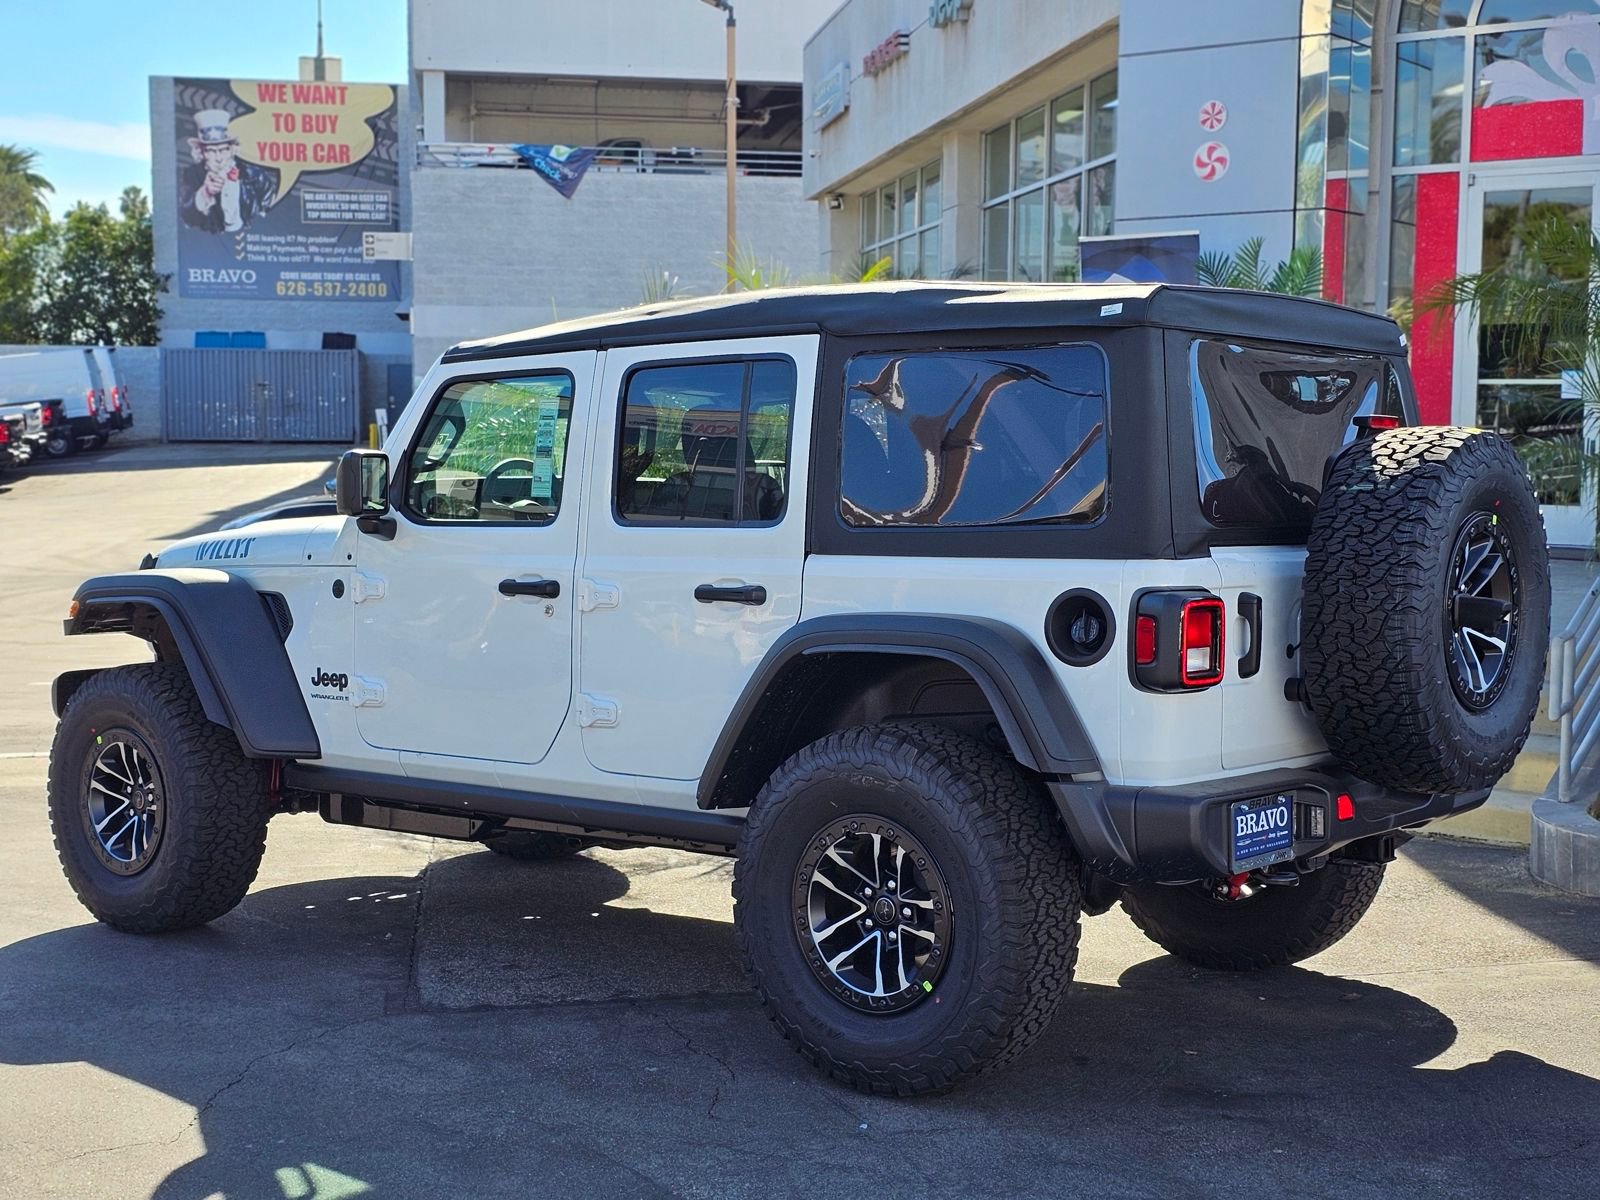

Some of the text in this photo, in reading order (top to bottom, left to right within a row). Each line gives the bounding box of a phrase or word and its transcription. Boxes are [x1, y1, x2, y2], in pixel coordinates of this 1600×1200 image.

[257, 84, 348, 105] WE WANT
[272, 112, 338, 134] TO BUY
[257, 142, 351, 163] YOUR CAR
[246, 244, 271, 253] Making
[188, 268, 257, 283] BRAVO
[276, 281, 387, 297] 626-537-2400
[195, 537, 256, 560] WILLYS
[311, 667, 348, 692] Jeep
[1236, 806, 1288, 836] BRAVO
